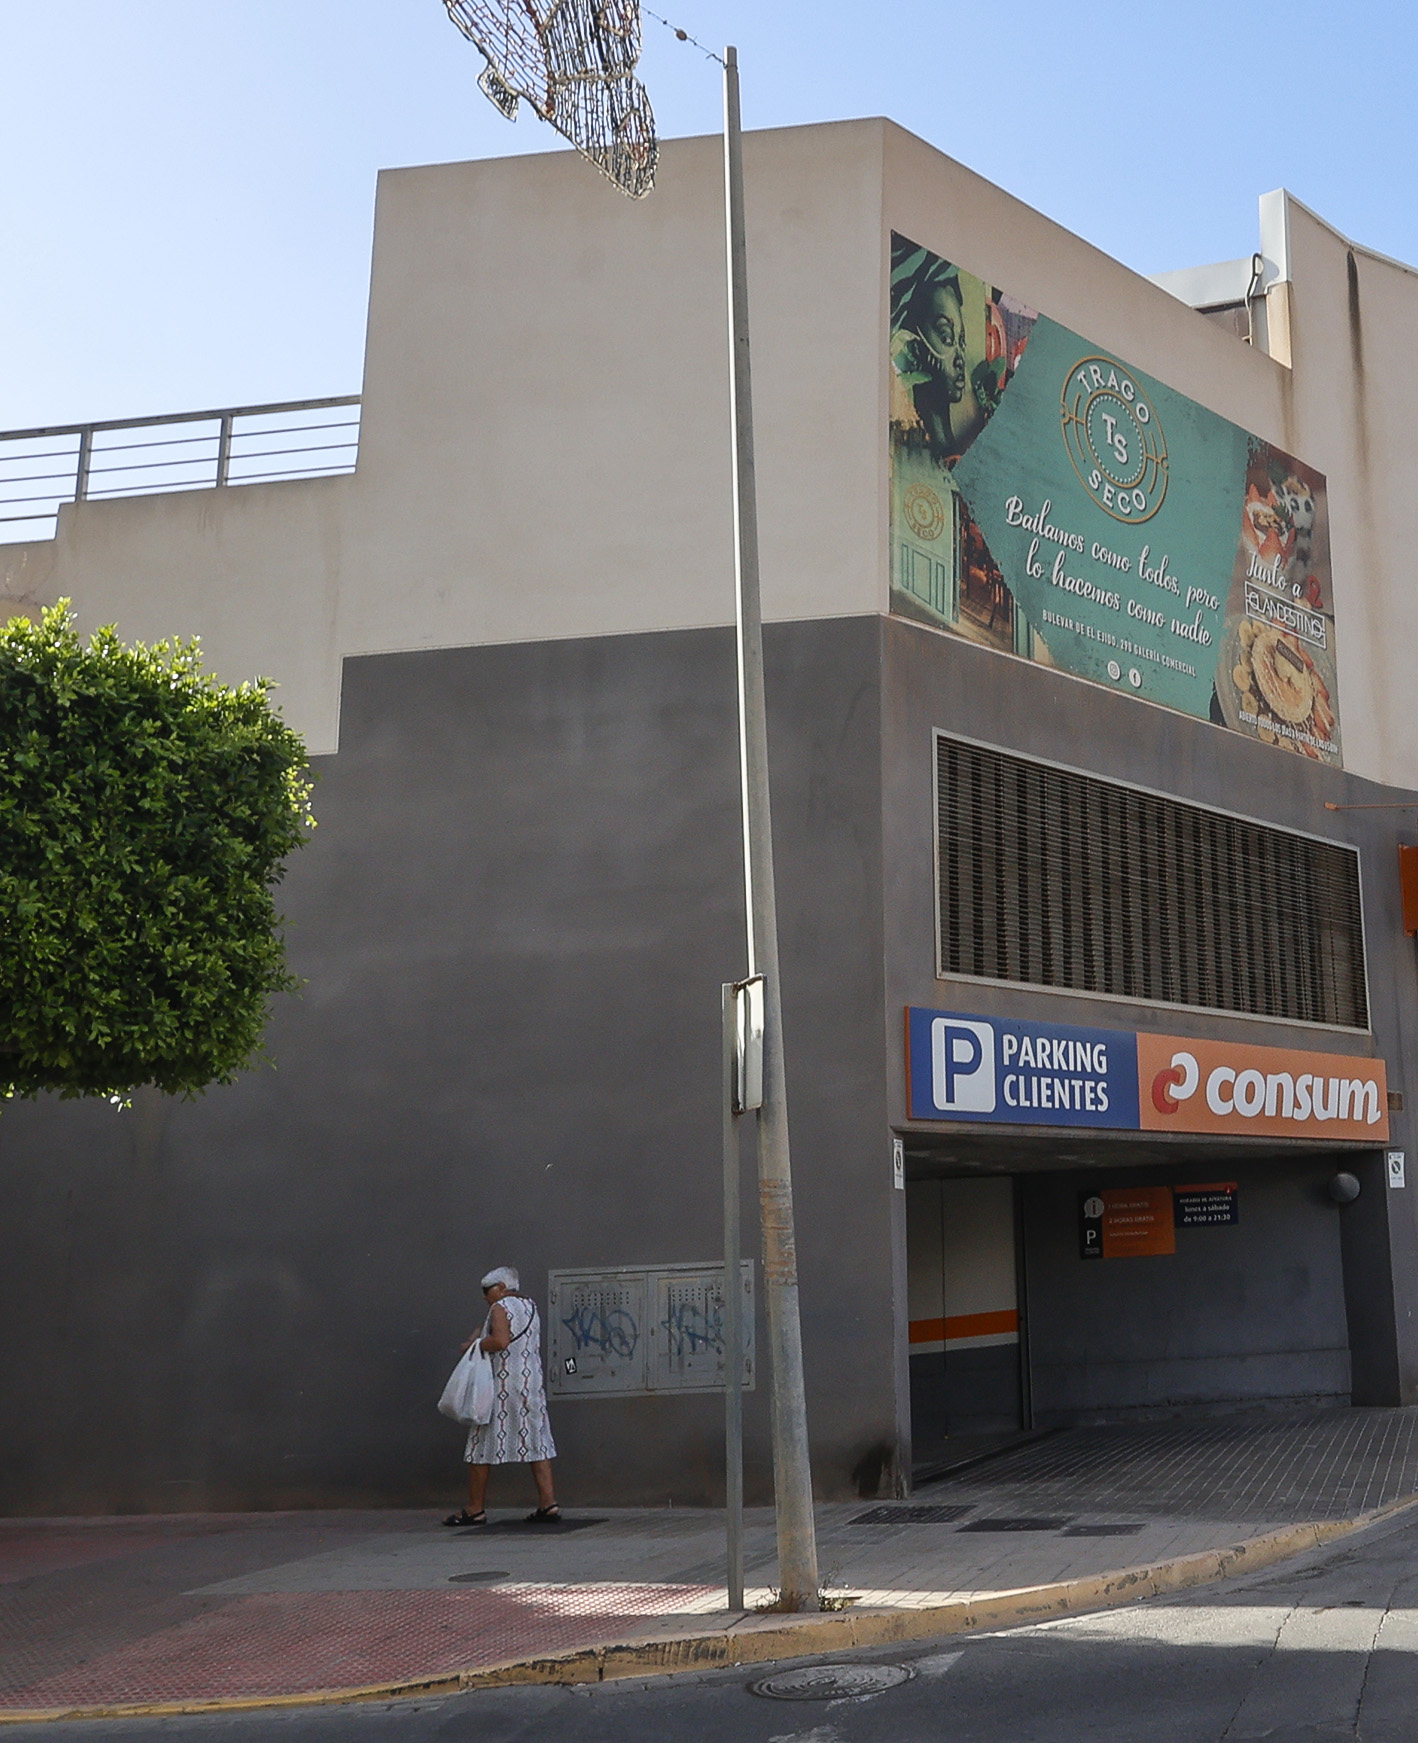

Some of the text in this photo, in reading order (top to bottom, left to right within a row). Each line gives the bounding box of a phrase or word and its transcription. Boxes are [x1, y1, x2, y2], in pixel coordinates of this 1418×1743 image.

[1077, 364, 1150, 424] TRAGO
[1102, 412, 1128, 464] TS
[1088, 469, 1147, 515] SECO
[1005, 495, 1220, 611] Bailamos como todos, pero
[1246, 550, 1303, 598] Junto a
[1025, 538, 1212, 647] lo hacemos como nadie
[1247, 590, 1323, 640] CLANDESTINO
[1042, 609, 1074, 631] BULEVAR
[1075, 621, 1085, 636] DE
[1086, 626, 1096, 639] EL
[1161, 655, 1196, 677] COMERCIAL
[1002, 1034, 1108, 1075] PARKING
[1003, 1074, 1109, 1112] CLIENTES
[1206, 1066, 1381, 1125] consum
